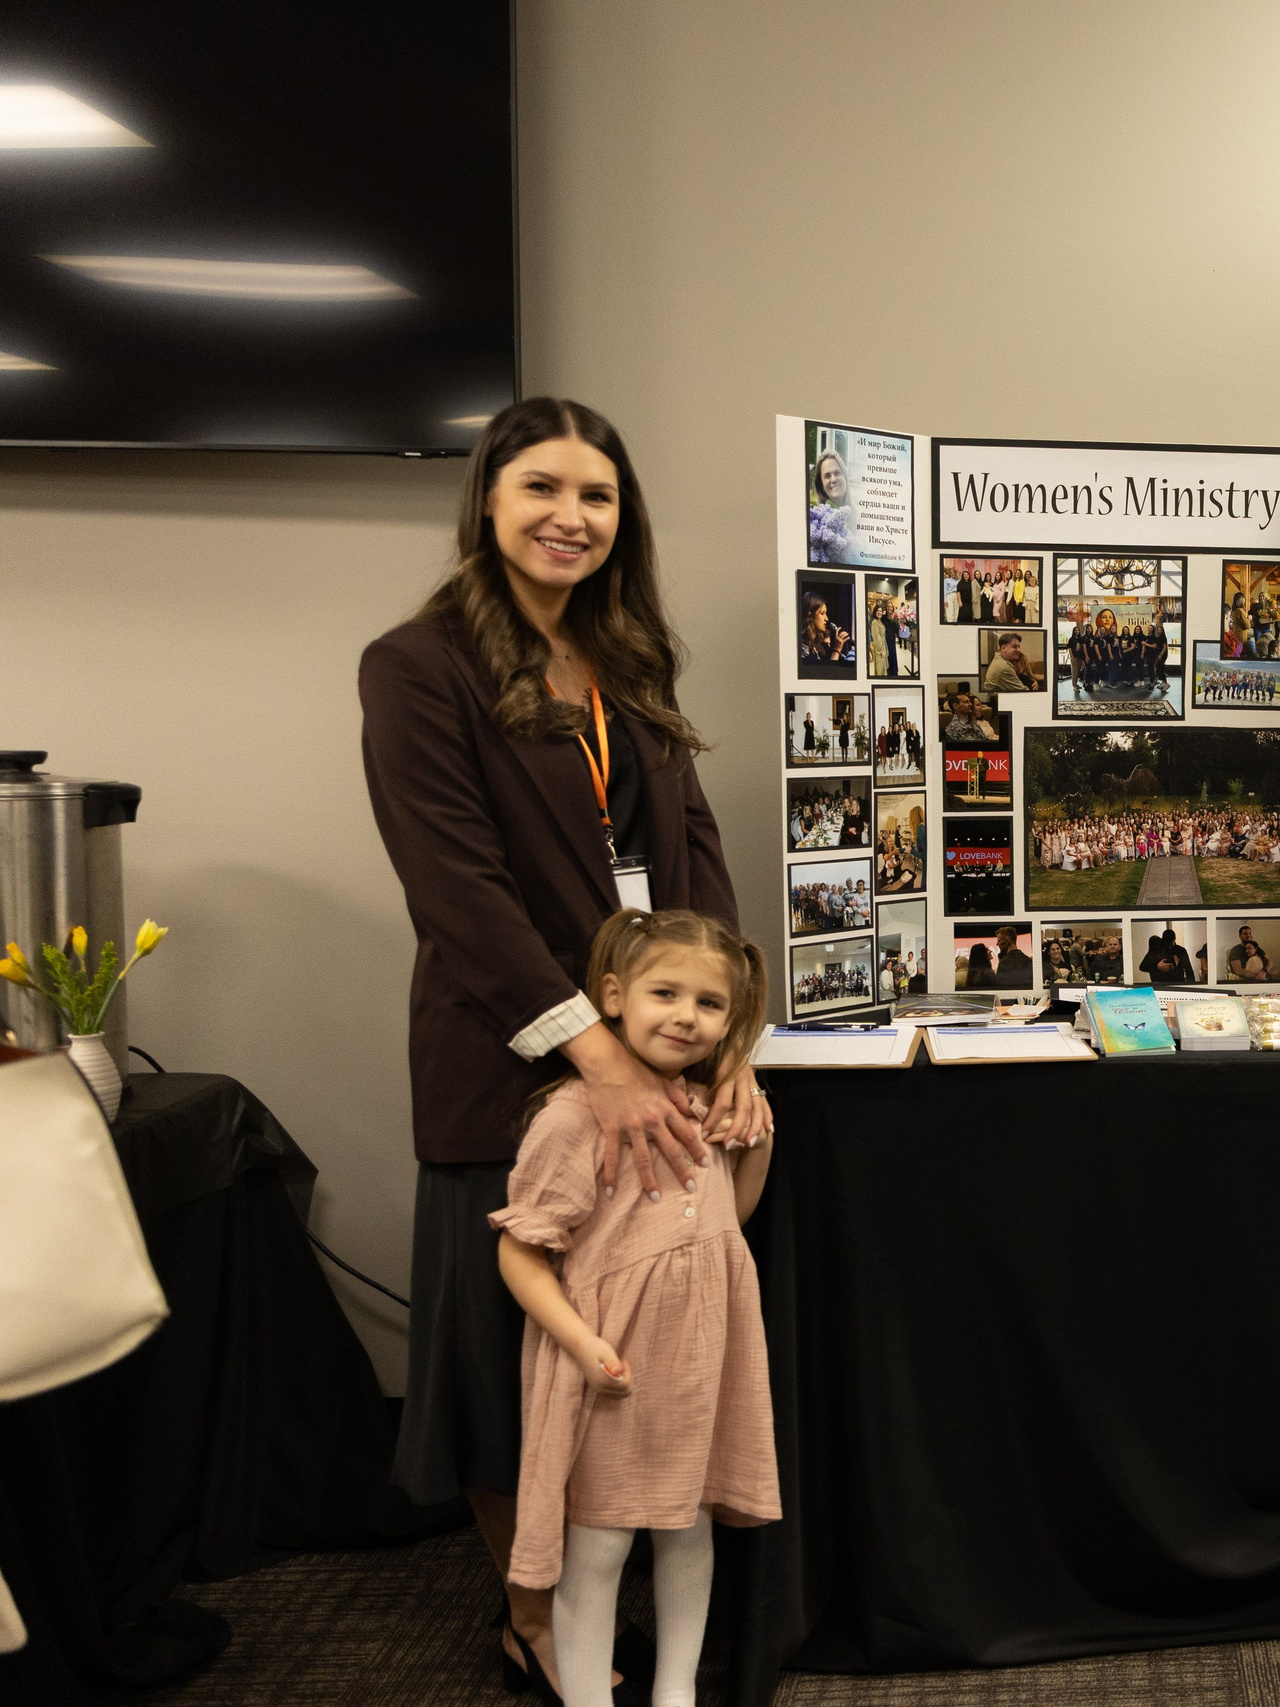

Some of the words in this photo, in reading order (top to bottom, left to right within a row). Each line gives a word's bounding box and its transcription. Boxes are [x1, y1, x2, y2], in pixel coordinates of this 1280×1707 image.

[868, 441, 881, 450] мир
[883, 440, 907, 452] Божий,
[867, 453, 897, 463] который
[867, 464, 898, 474] превыше
[861, 476, 888, 485] всякого
[889, 479, 903, 487] ума,
[867, 488, 898, 498] соблюдет
[950, 471, 1113, 516] Women's
[858, 500, 882, 509] сердца
[882, 503, 900, 511] ваши
[860, 512, 905, 523] помышления
[856, 523, 875, 532] ваши
[885, 525, 909, 535] Христе
[1128, 618, 1150, 626] Bible
[959, 852, 1003, 860] LOVEBANK
